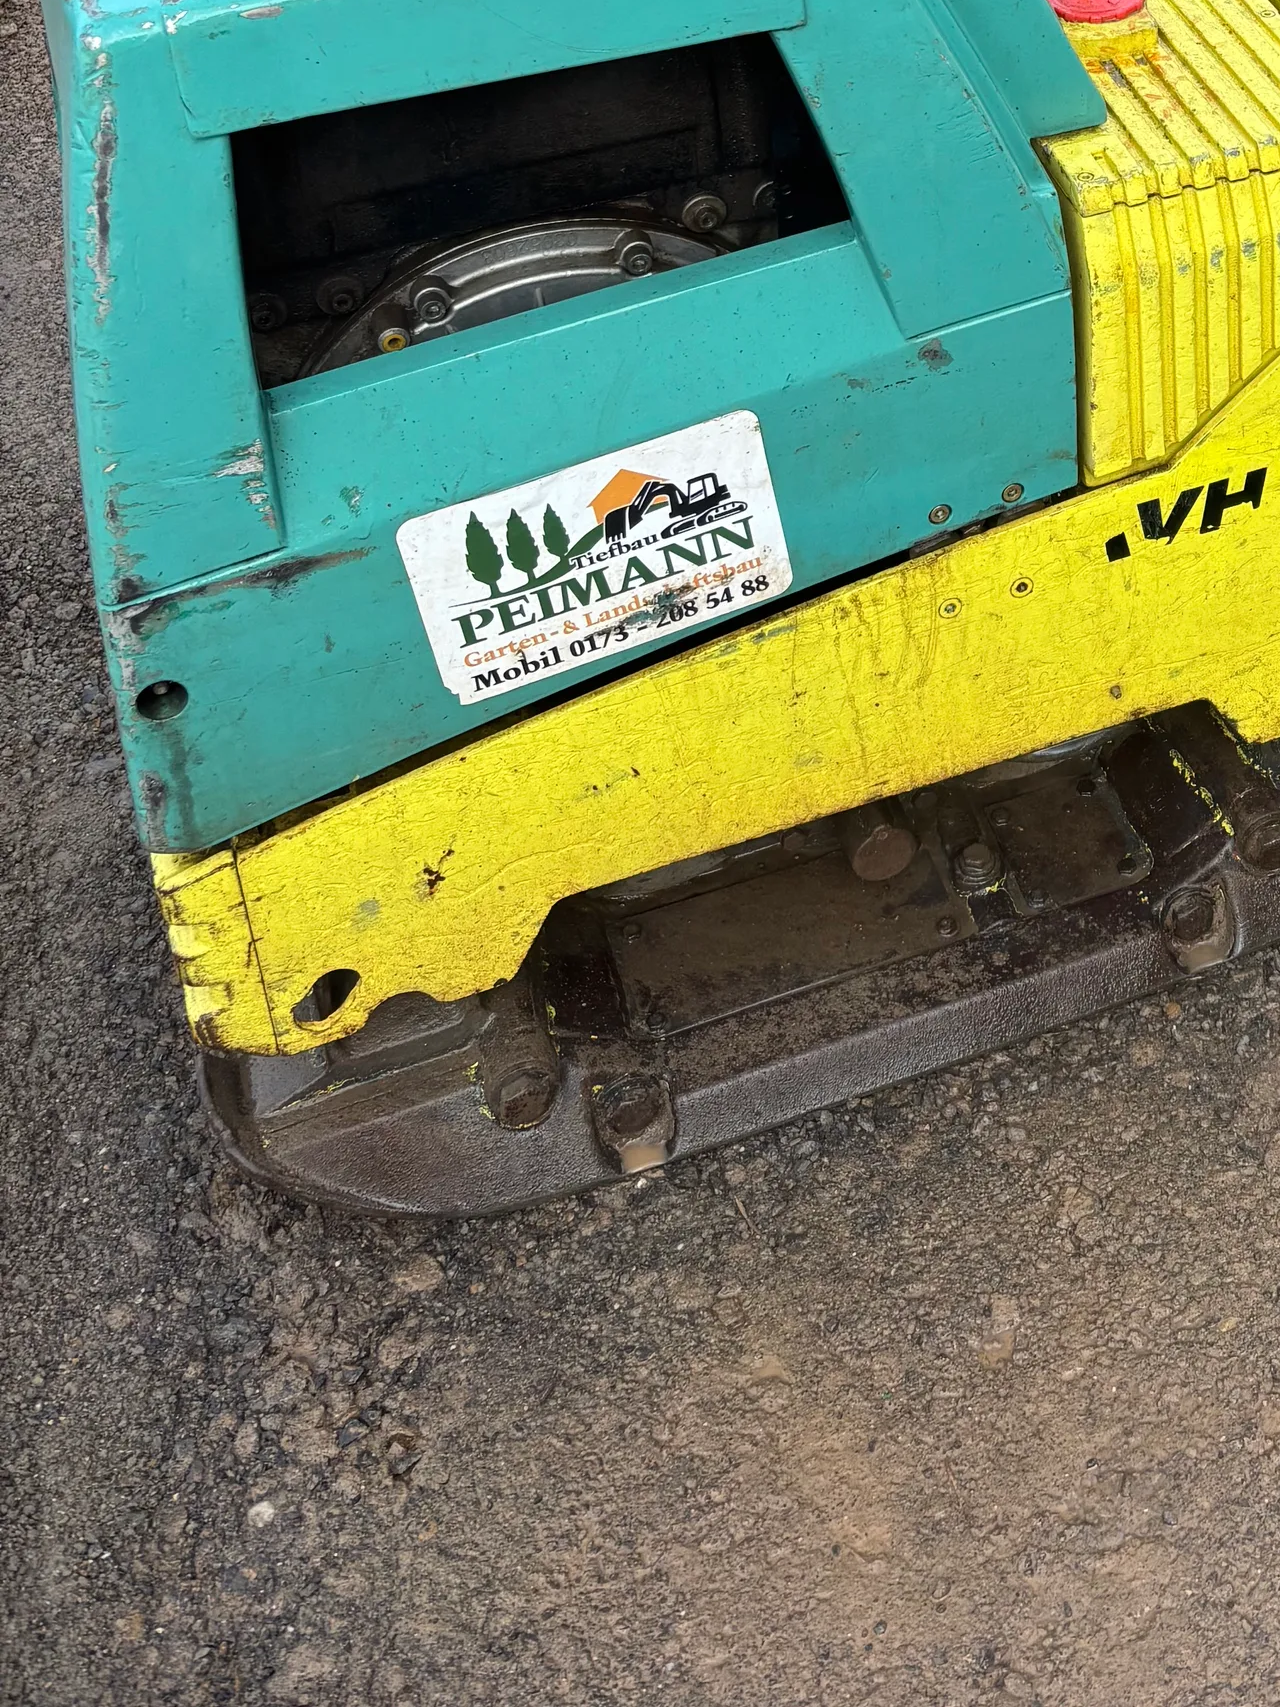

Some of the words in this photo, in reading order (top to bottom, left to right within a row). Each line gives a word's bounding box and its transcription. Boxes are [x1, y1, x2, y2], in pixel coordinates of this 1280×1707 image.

[451, 515, 755, 648] PEIMANN
[571, 533, 660, 571] Tiefbau
[471, 646, 565, 692] Mobil
[570, 625, 629, 657] 0173
[656, 601, 699, 629] 208
[707, 587, 735, 610] 54
[741, 575, 769, 597] 88
[563, 620, 580, 635] &
